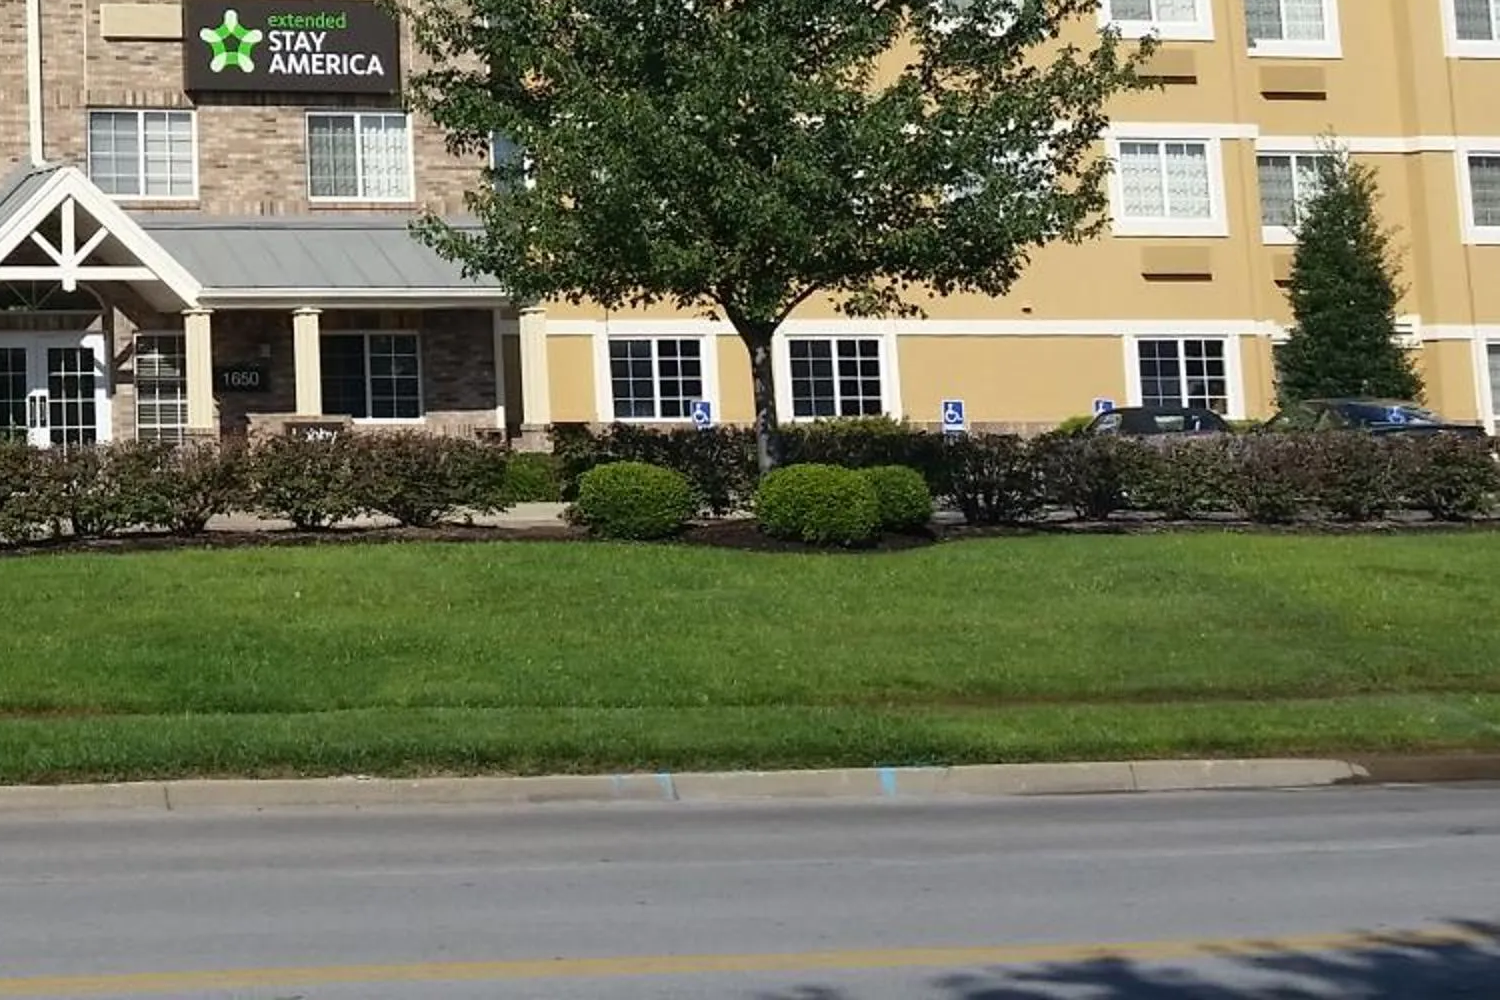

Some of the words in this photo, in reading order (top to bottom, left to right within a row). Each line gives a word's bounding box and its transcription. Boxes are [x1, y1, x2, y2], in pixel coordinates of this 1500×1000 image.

[267, 12, 347, 29] extended
[268, 31, 326, 52] STAY
[268, 54, 385, 75] AMERICA
[223, 371, 260, 387] 1650
